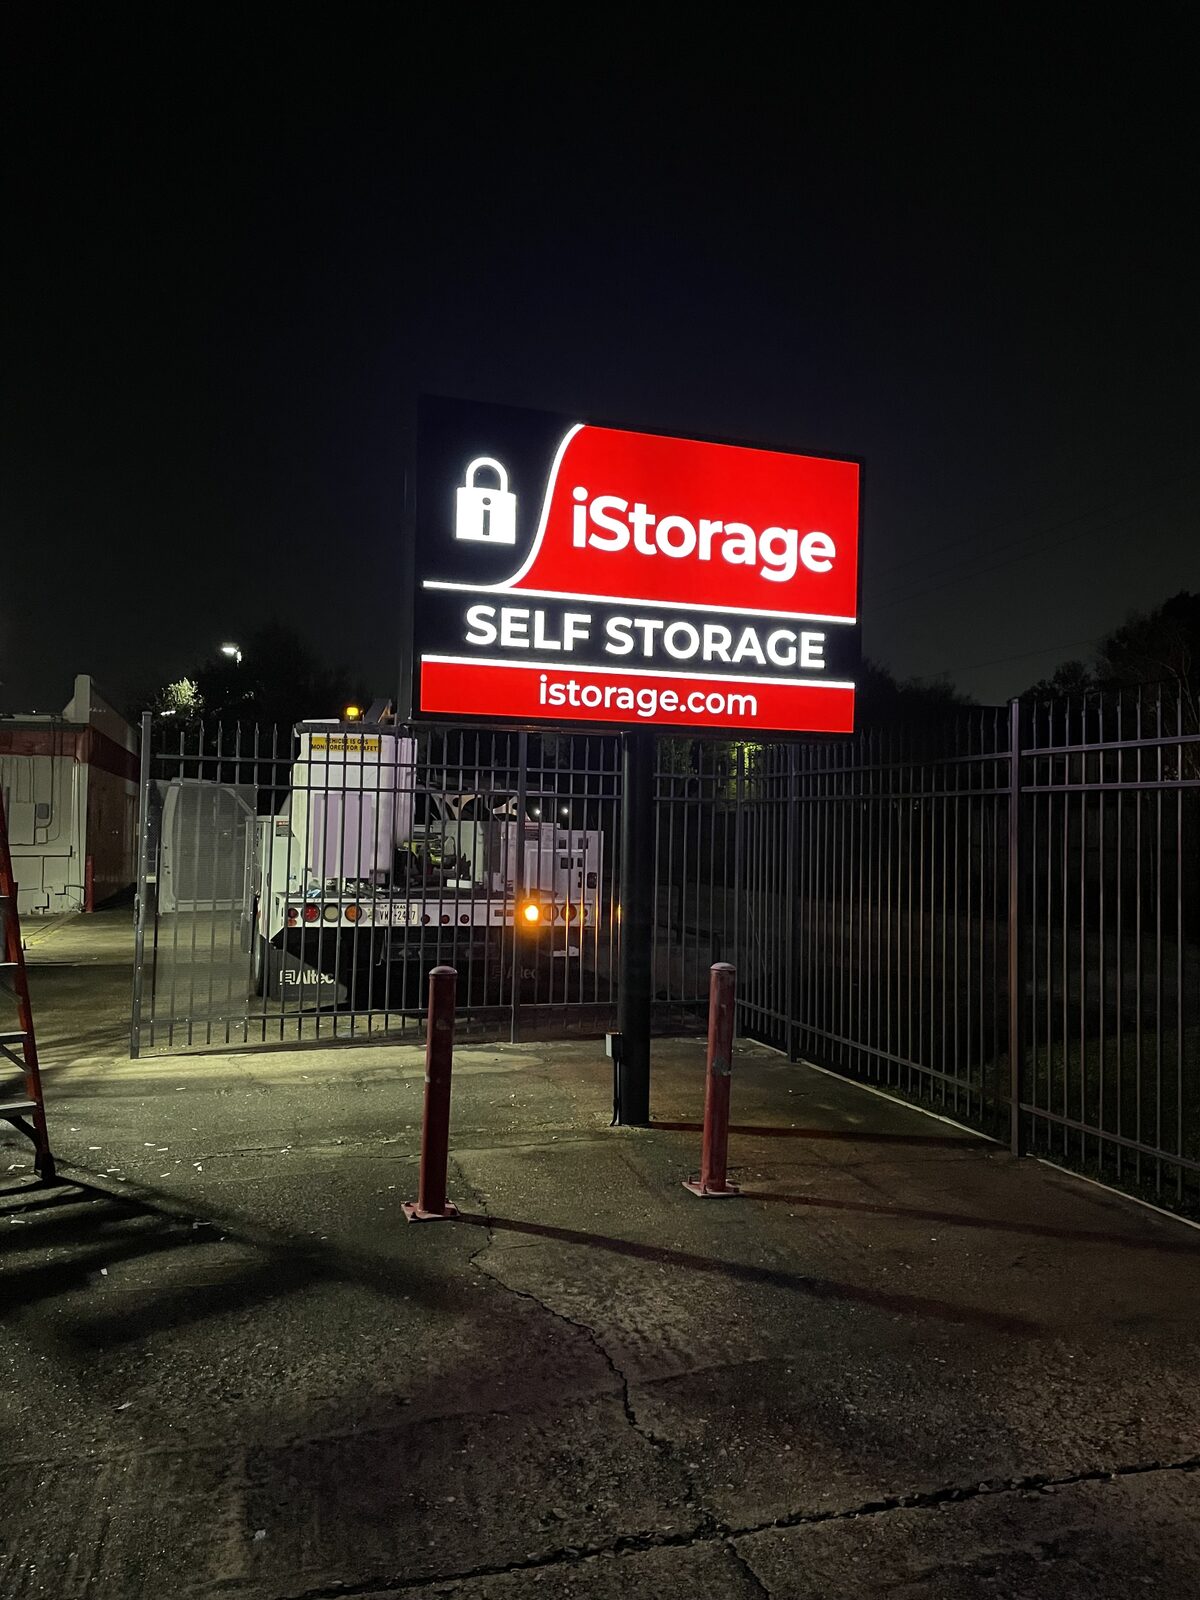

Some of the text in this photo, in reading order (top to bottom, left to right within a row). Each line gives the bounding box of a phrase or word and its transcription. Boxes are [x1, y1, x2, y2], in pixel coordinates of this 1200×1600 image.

[572, 487, 837, 582] iStorage
[465, 605, 826, 669] SELF STORAGE
[539, 674, 757, 717] istorage.com
[296, 969, 334, 985] Altec
